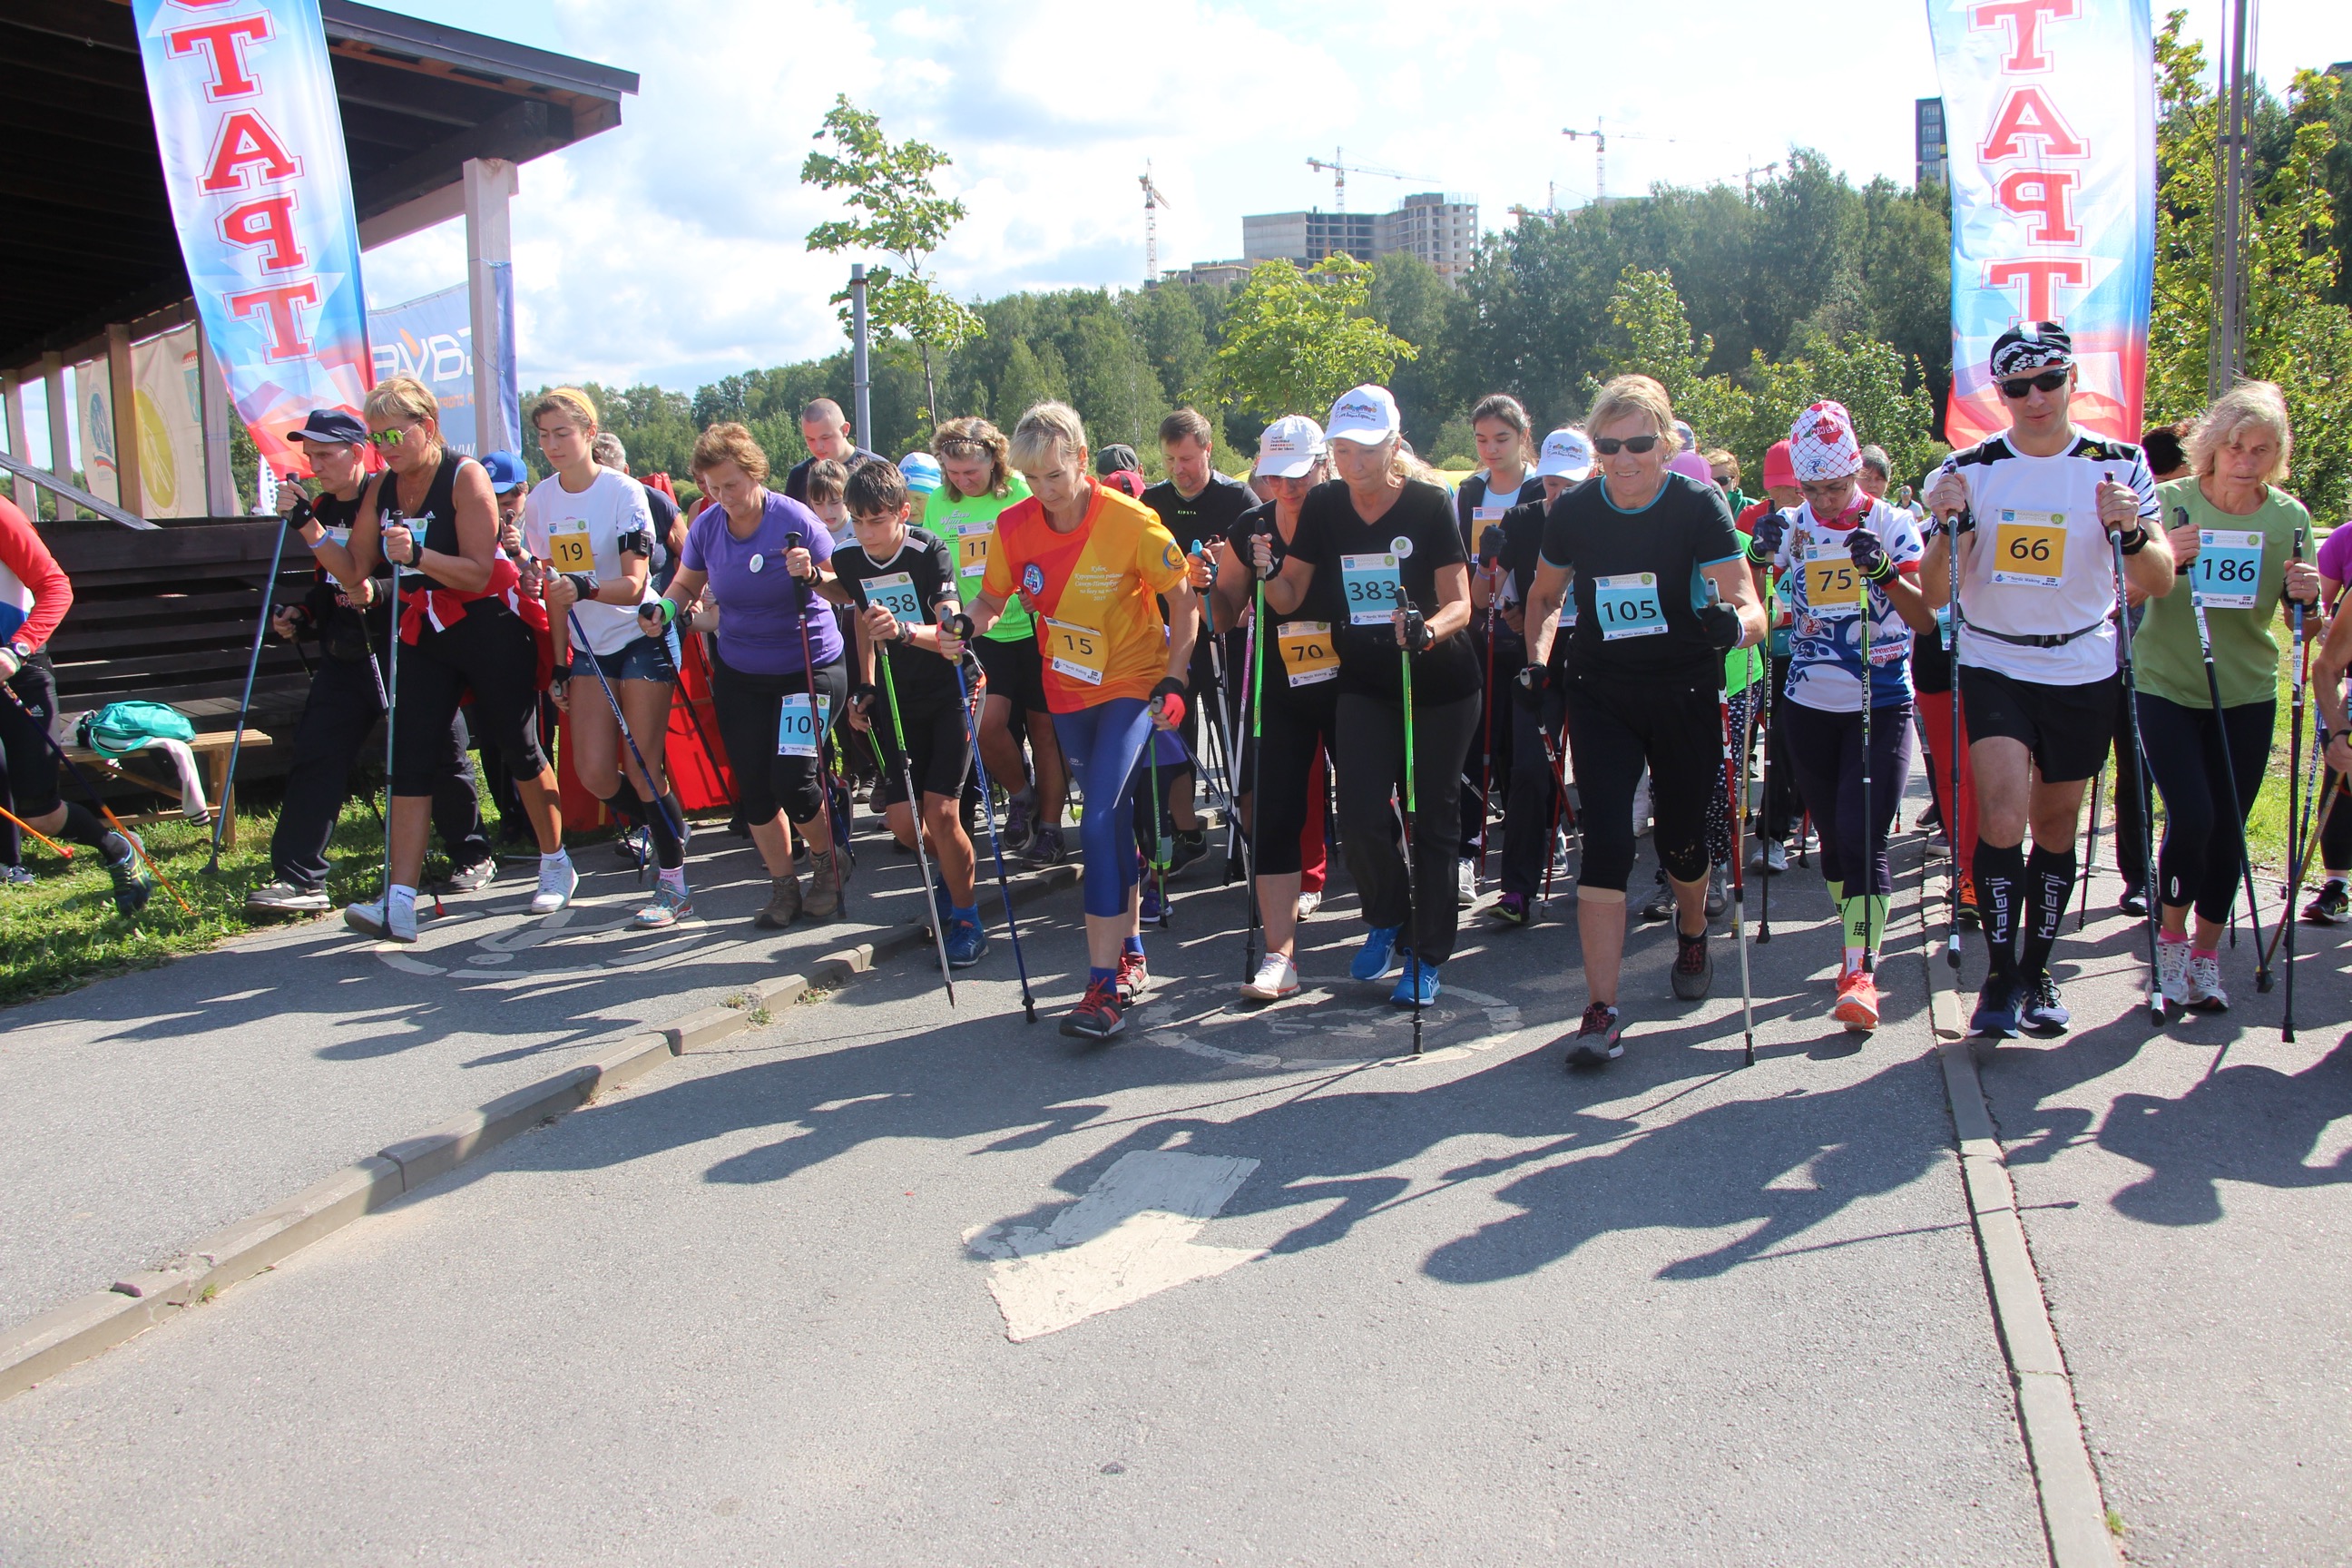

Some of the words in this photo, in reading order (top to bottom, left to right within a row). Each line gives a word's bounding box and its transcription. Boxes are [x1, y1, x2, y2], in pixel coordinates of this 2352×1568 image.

[560, 543, 583, 562] 19
[2010, 537, 2049, 561] 66
[1818, 569, 1851, 592] 75
[2202, 559, 2255, 582] 186
[1348, 581, 1396, 601] 383
[1602, 600, 1657, 622] 105
[1063, 635, 1093, 655] 15
[1291, 644, 1324, 662] 70
